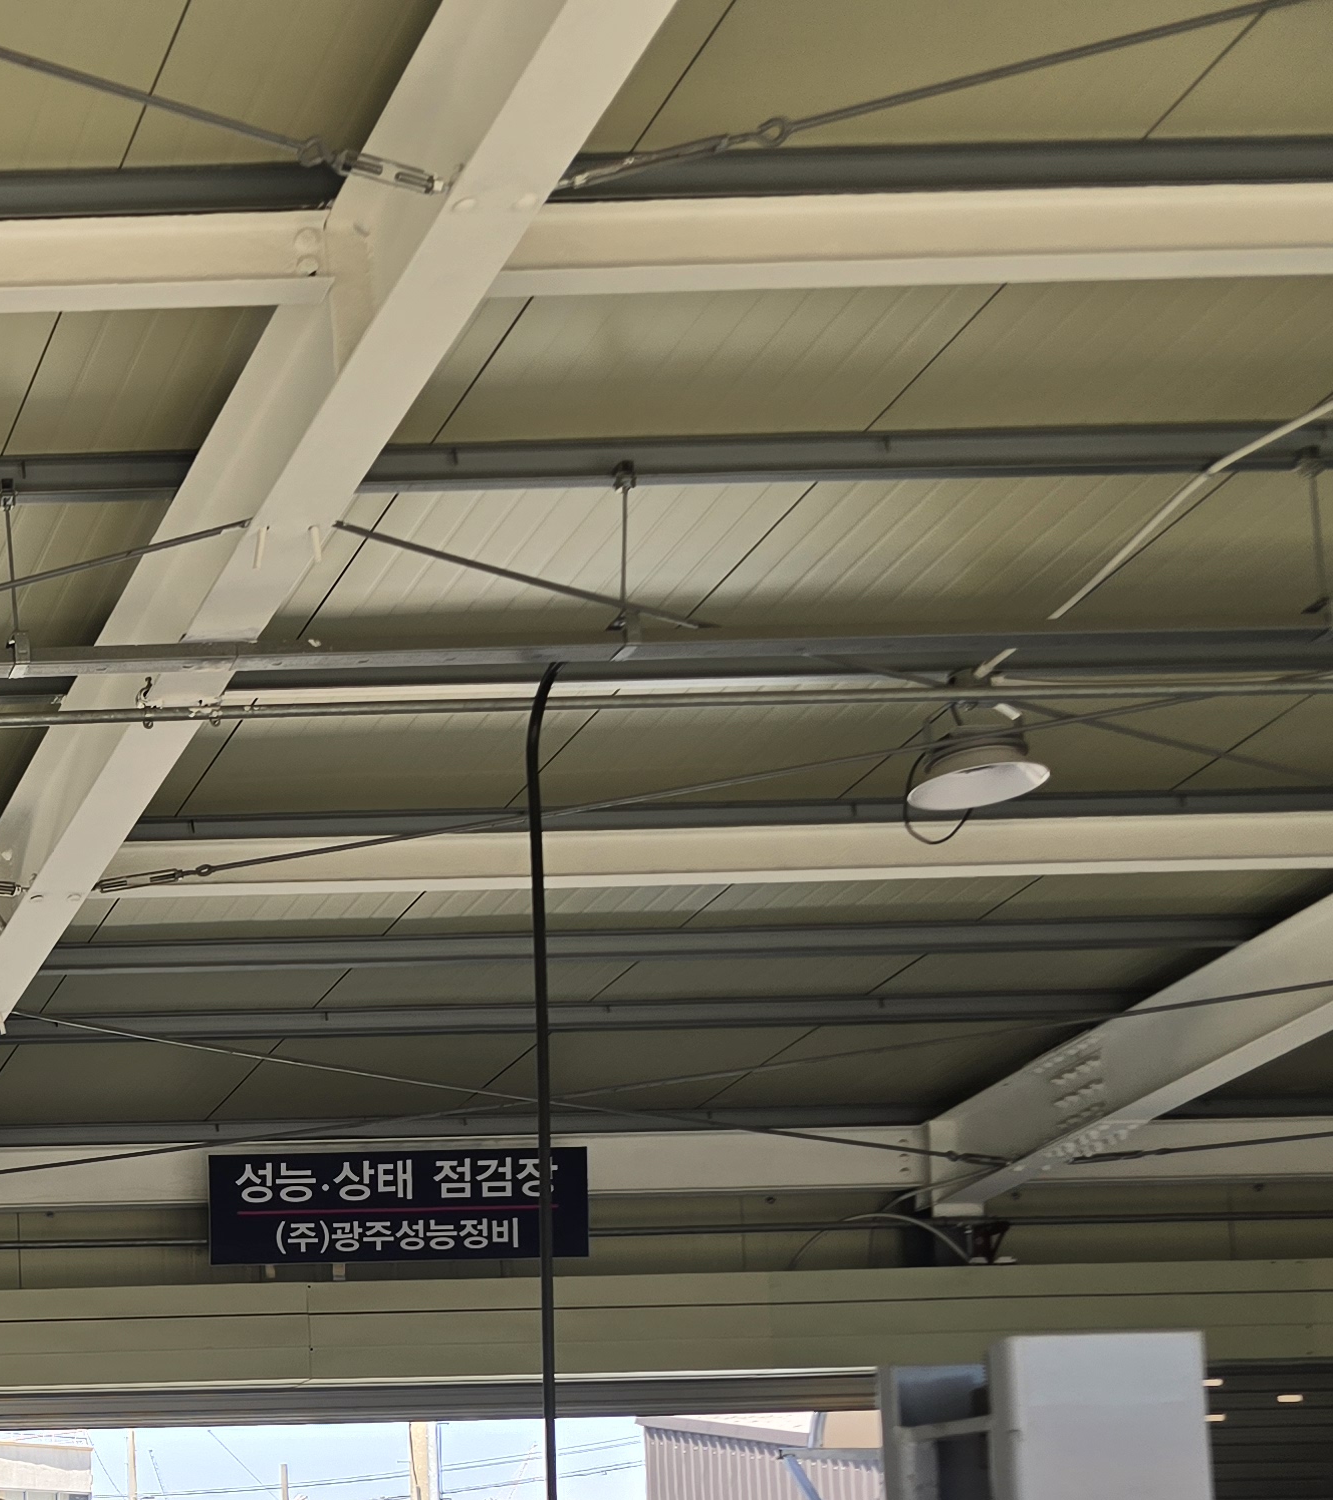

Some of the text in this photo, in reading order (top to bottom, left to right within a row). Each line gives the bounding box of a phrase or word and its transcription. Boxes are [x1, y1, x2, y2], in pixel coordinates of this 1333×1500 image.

[235, 1156, 558, 1203] 성능·상태 점검장
[276, 1218, 519, 1254] (주)광주성능정비
